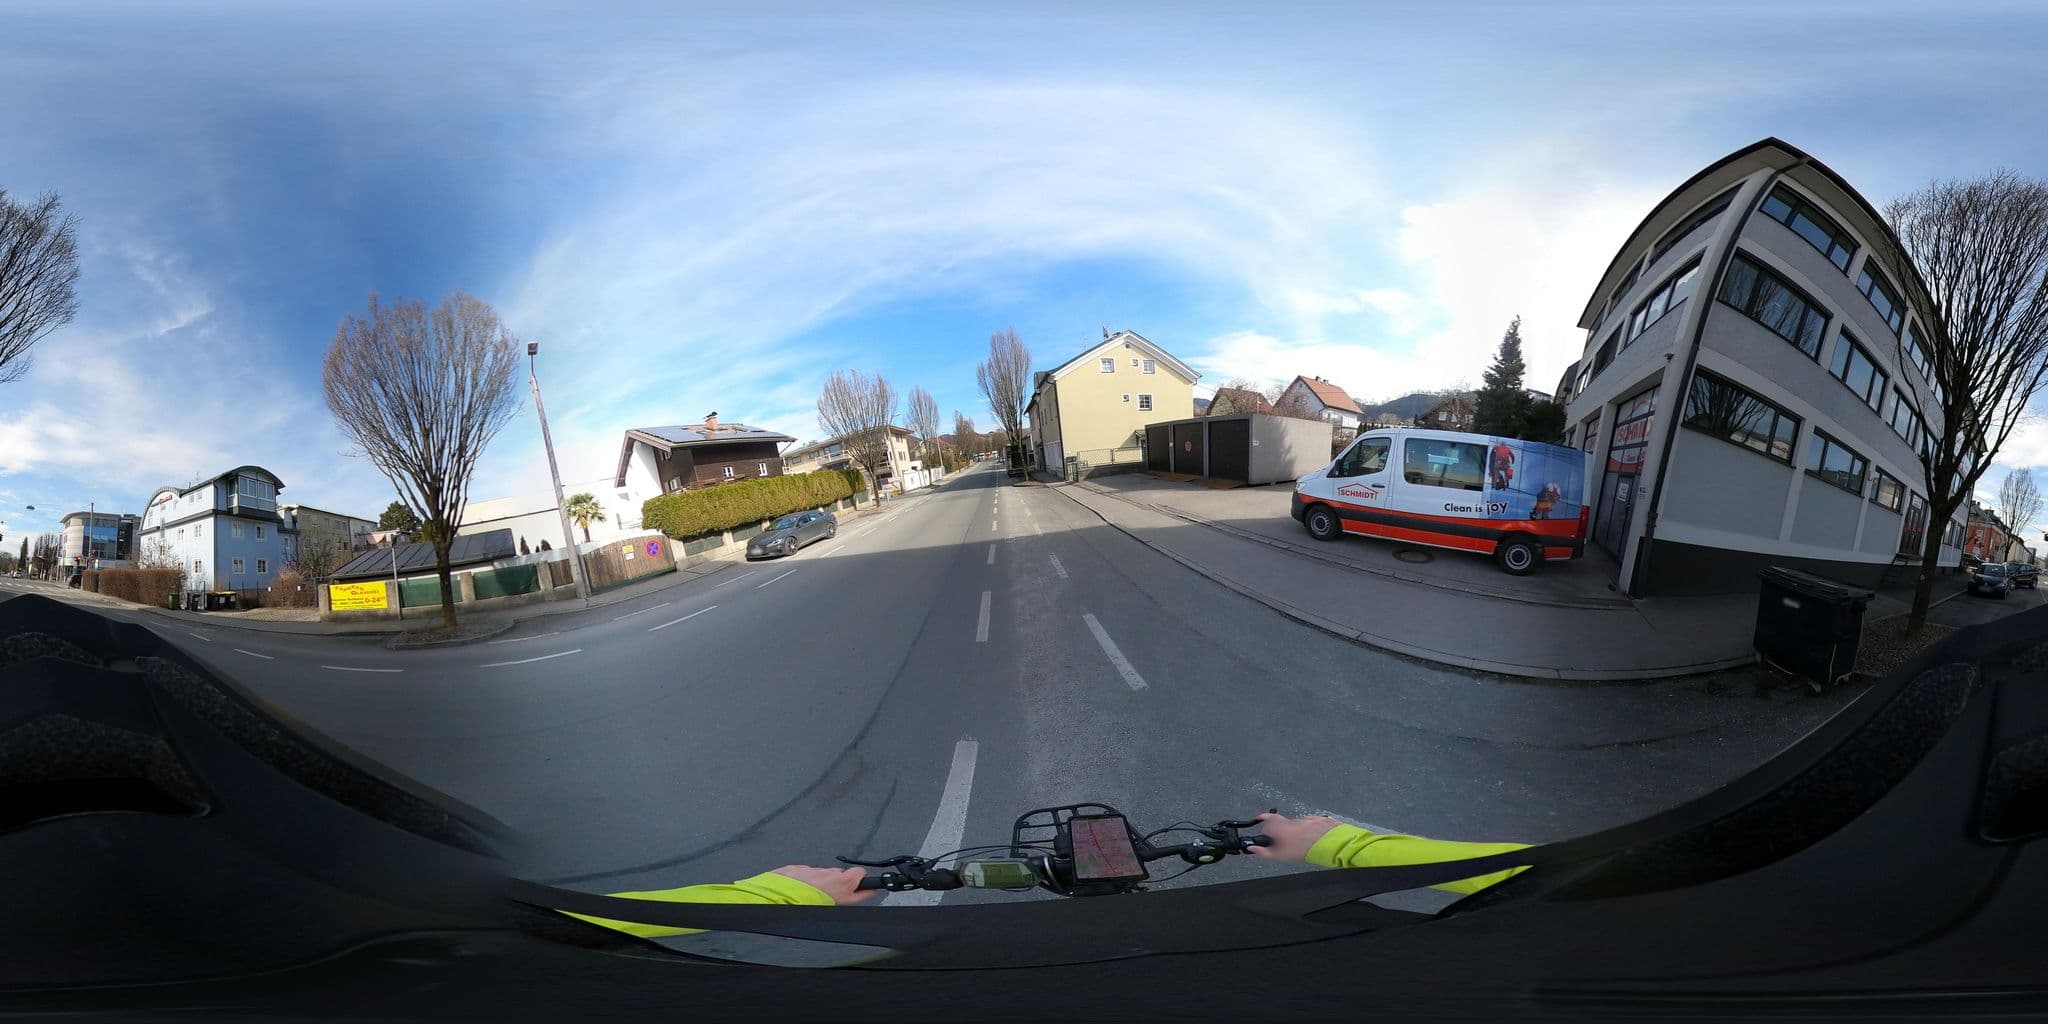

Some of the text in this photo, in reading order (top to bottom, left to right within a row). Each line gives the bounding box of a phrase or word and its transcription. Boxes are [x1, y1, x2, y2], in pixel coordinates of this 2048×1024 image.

[1340, 489, 1376, 499] SCHMIDT
[1444, 500, 1508, 516] Clean is joy
